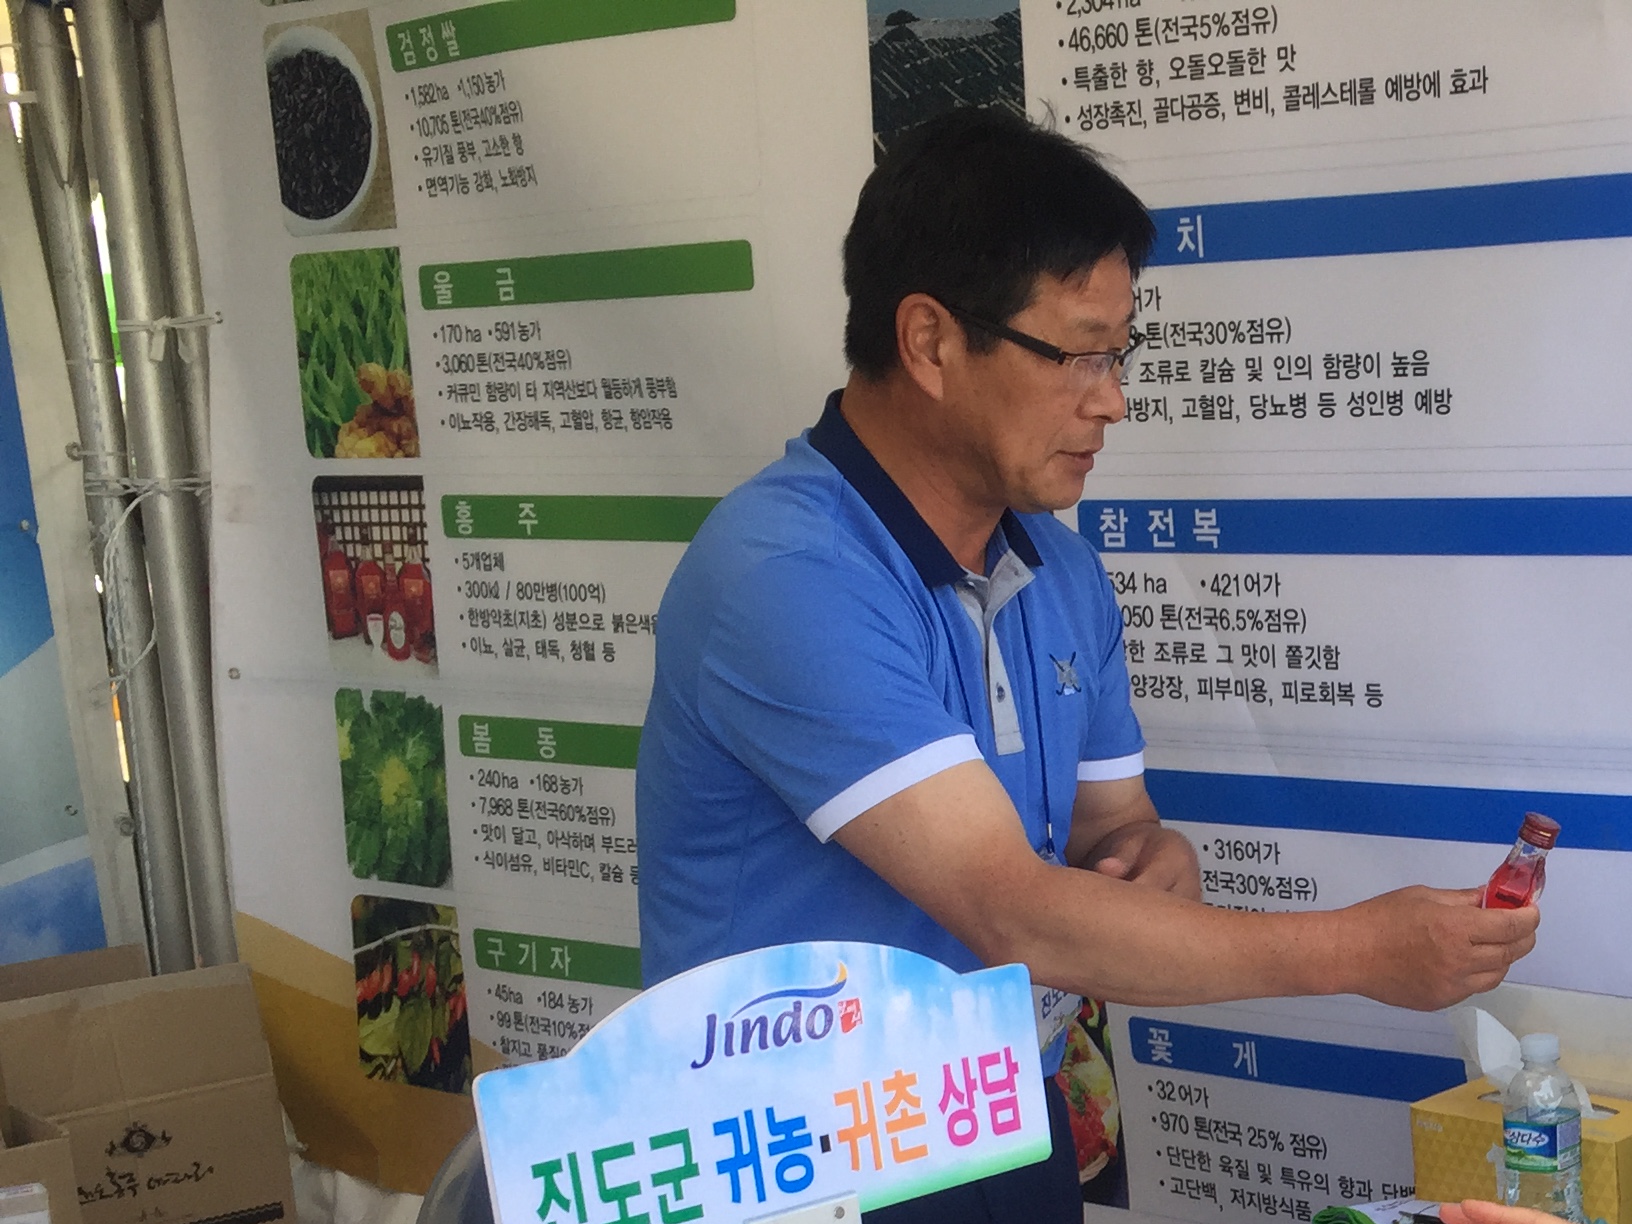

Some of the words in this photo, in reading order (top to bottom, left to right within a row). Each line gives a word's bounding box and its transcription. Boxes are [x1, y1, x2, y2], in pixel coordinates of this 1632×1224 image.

[1068, 21, 1128, 54] 46,660
[1134, 4, 1278, 47] 톤(전국5%점유)
[1073, 61, 1127, 92] 특출한
[1136, 58, 1160, 88] 향,
[1168, 47, 1267, 80] 오돌오돌한
[1276, 44, 1297, 73] 맛
[1077, 99, 1147, 131] 성장촉진,
[1153, 92, 1226, 124] 골다공증,
[1233, 87, 1275, 117] 변비,
[1282, 77, 1376, 112] 콜레스테롤
[1385, 69, 1441, 102] 예방에
[1449, 65, 1489, 96] 효과
[1177, 214, 1204, 258] 치
[1139, 360, 1192, 386] 조류로
[1200, 357, 1236, 384] 칼슘
[1245, 355, 1264, 383] 및
[1273, 354, 1313, 381] 인의
[1323, 352, 1381, 380] 함량이
[1391, 349, 1430, 378] 높음
[1182, 394, 1240, 423] 고혈압,
[1250, 392, 1307, 420] 당뇨병
[1317, 392, 1337, 419] 등
[1347, 390, 1403, 418] 성인병
[1414, 388, 1453, 416] 예방
[1144, 573, 1167, 594] ha
[553, 612, 605, 632] 성분으로
[1160, 604, 1306, 634] 톤(전국6.5%점유)
[602, 642, 616, 663] 등
[1154, 641, 1207, 665] 조류로
[1216, 645, 1234, 664] 그
[1241, 644, 1276, 668] 맛이
[1285, 644, 1340, 670] 쫄깃함
[1197, 677, 1273, 706] 피부미용,
[1282, 680, 1355, 707] 피로회복
[1364, 683, 1384, 708] 등
[481, 823, 506, 844] 맛이
[1214, 838, 1280, 865] 316어가
[599, 862, 624, 883] 칼슘
[690, 993, 833, 1070] Jindo
[936, 1046, 1022, 1148] 상담
[1161, 1111, 1189, 1135] 970
[1248, 1127, 1284, 1152] 25%
[1290, 1133, 1328, 1161] 점유)
[1167, 1145, 1211, 1172] 단단한
[1219, 1155, 1249, 1181] 육질
[1257, 1163, 1272, 1186] 및
[1280, 1167, 1330, 1195] 특유의
[1338, 1175, 1373, 1200] 향과
[1170, 1176, 1223, 1212] 고단백,
